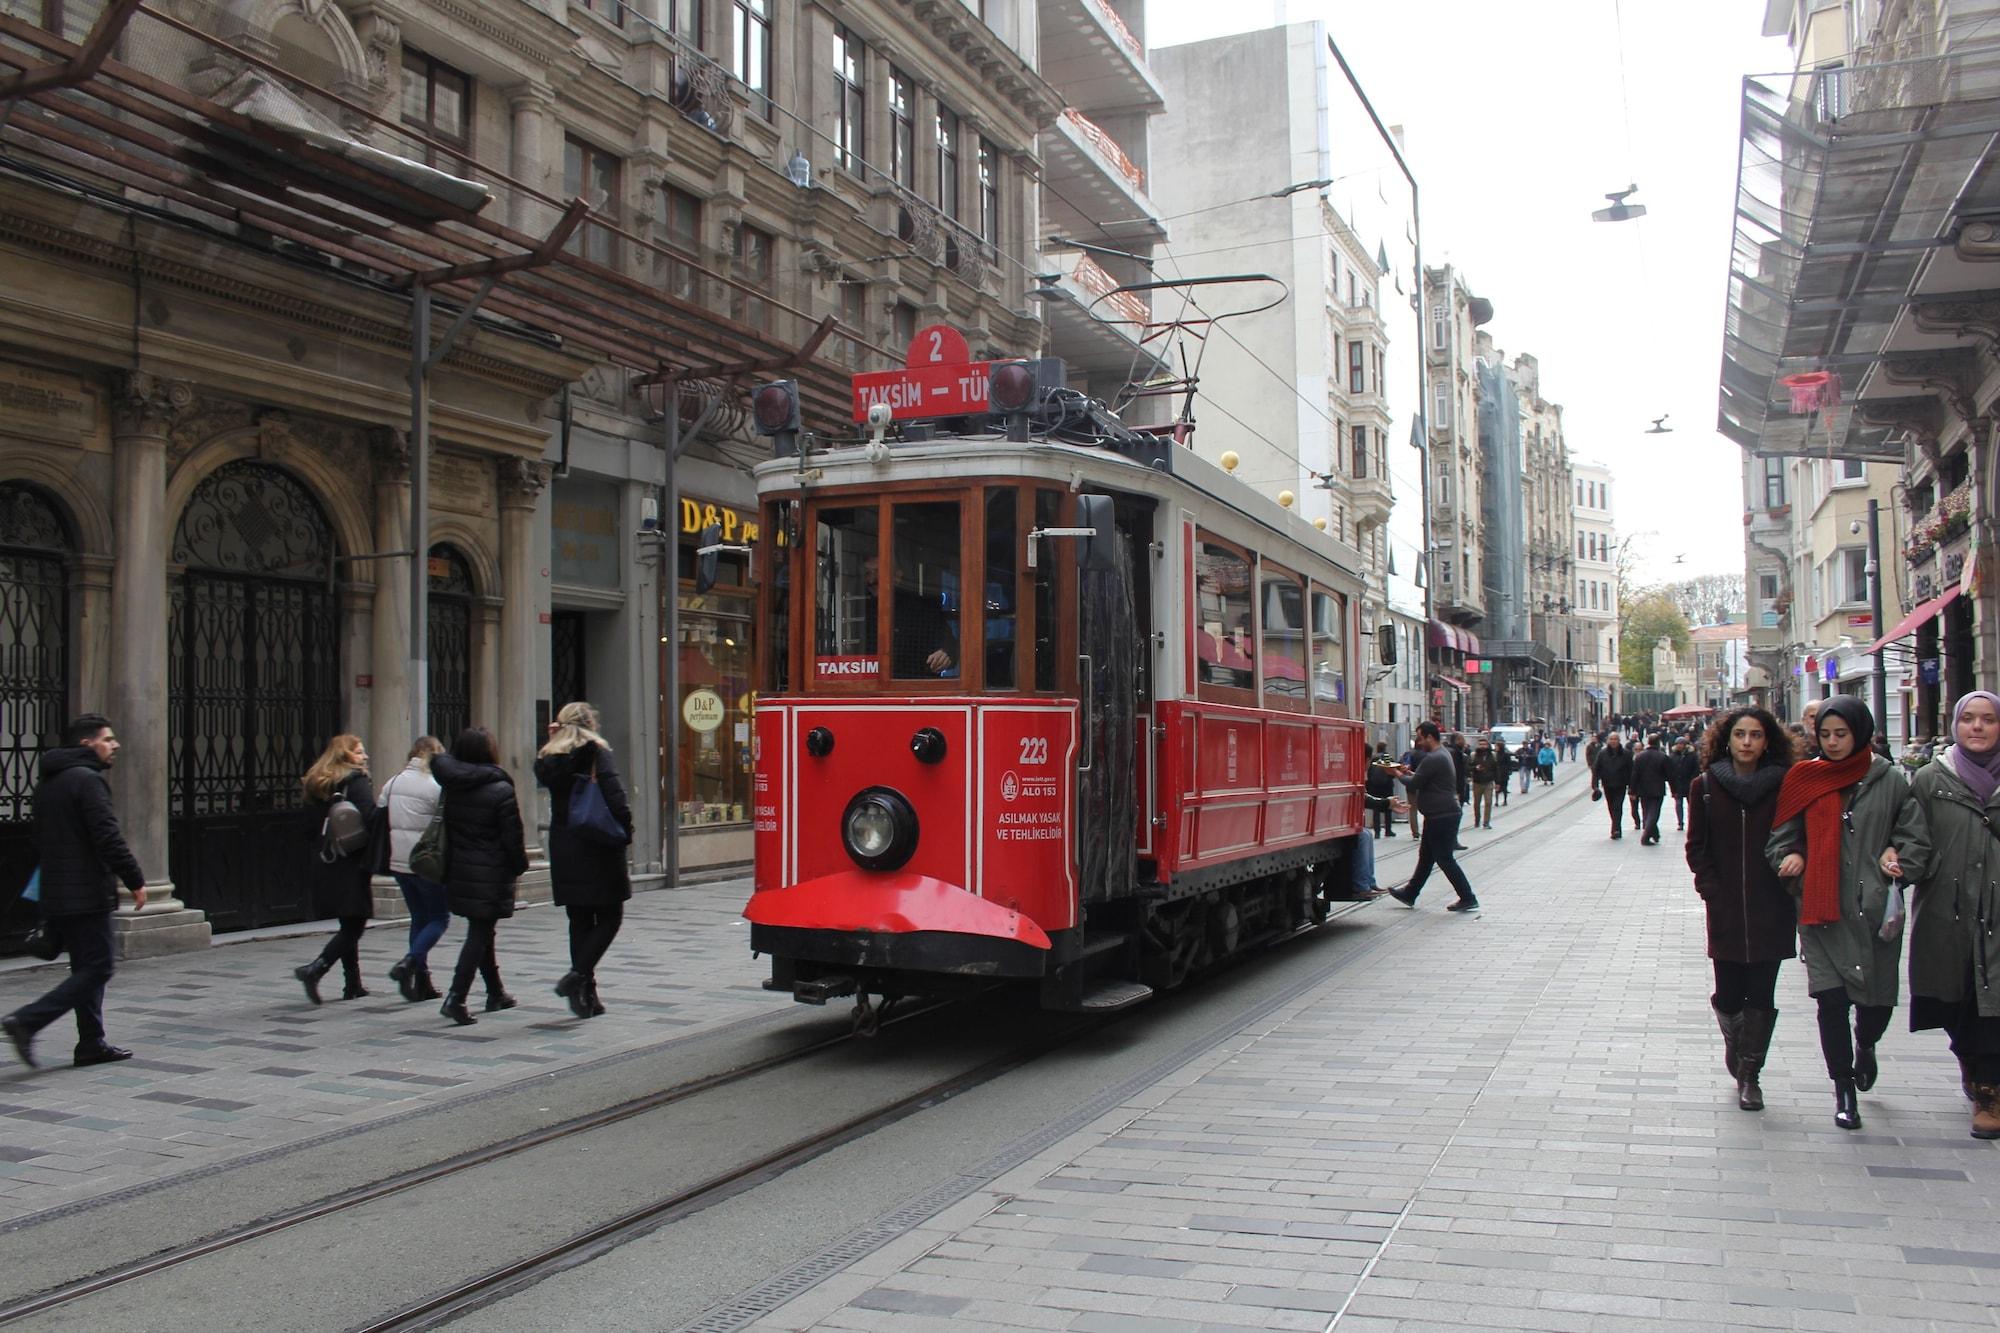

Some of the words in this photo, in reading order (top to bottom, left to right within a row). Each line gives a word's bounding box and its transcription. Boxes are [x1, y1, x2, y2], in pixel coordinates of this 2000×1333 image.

[929, 330, 943, 362] 2
[858, 376, 922, 411] TAKSİM
[958, 369, 990, 402] TÜN
[680, 497, 738, 542] D&P
[817, 658, 879, 674] TAKSİM
[693, 697, 715, 711] D&P
[1019, 736, 1048, 765] 223
[1021, 786, 1041, 796] ALO
[1042, 786, 1057, 796] 153
[998, 812, 1038, 824] ASILMAK
[1039, 811, 1061, 823] YASAK
[996, 829, 1009, 840] VE
[1010, 826, 1062, 841] TEHLİKELİDİR
